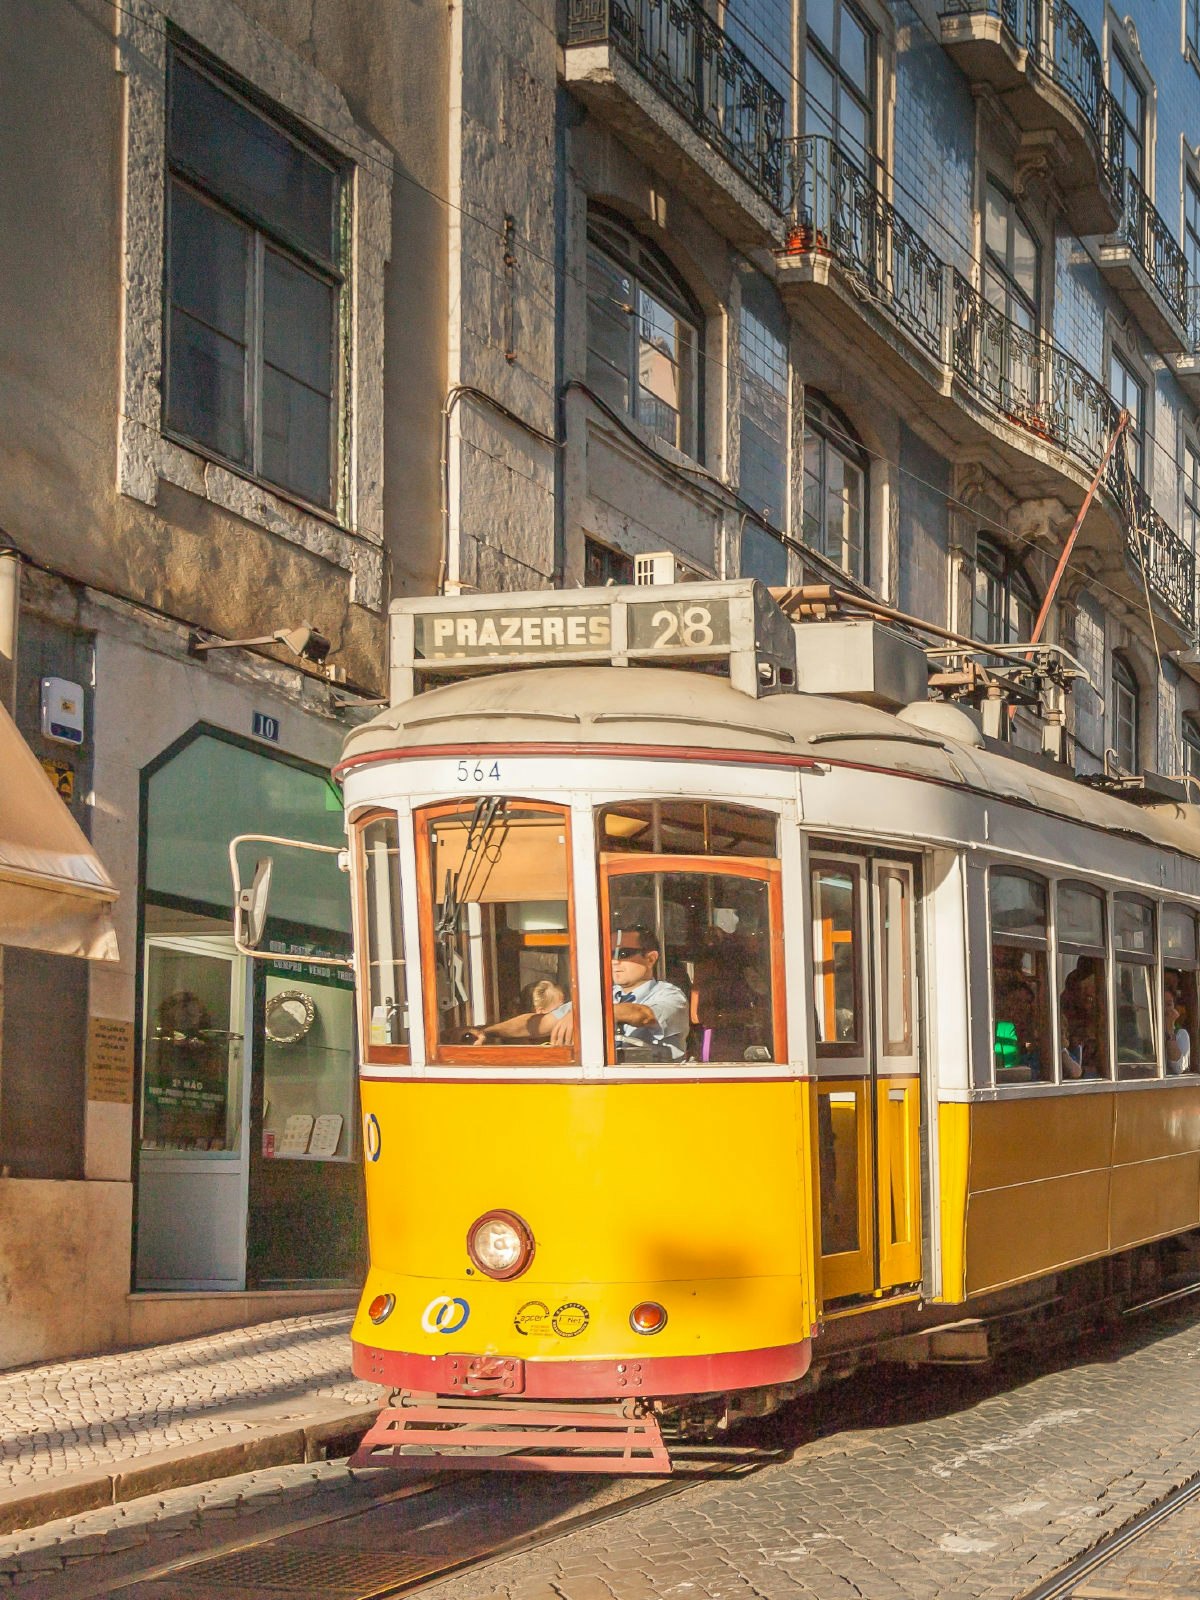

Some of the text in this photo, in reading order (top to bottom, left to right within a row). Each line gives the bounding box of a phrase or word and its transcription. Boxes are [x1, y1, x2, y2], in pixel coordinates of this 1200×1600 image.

[434, 606, 714, 649] PRAZERES 28
[259, 715, 275, 738] 10
[457, 760, 502, 782] 564
